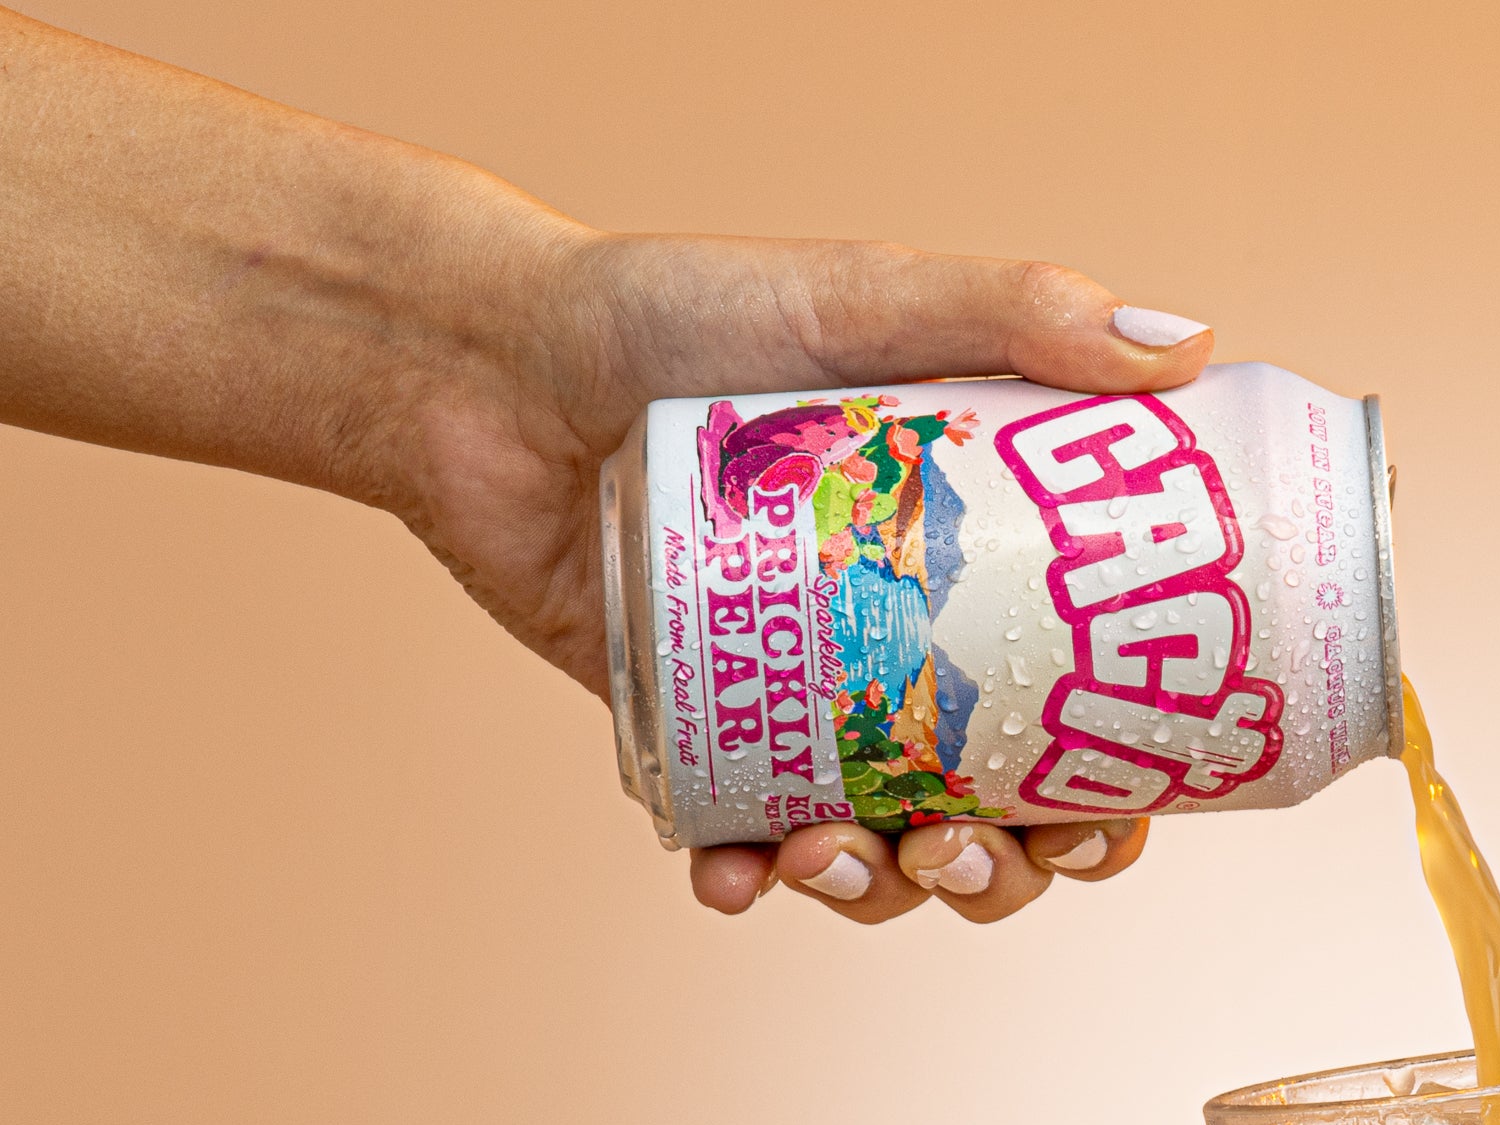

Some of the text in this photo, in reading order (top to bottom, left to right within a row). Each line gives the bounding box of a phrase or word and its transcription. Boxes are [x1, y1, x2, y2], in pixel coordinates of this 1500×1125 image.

[1307, 402, 1336, 566] LOW IN SUGAR
[661, 526, 699, 767] Made From Real Fruit
[703, 532, 762, 752] PEAR
[752, 488, 813, 784] PRICKLY
[806, 576, 840, 701] Sparkling
[994, 393, 1285, 814] CACTO
[1325, 625, 1346, 719] CACTUS
[813, 802, 855, 824] 2
